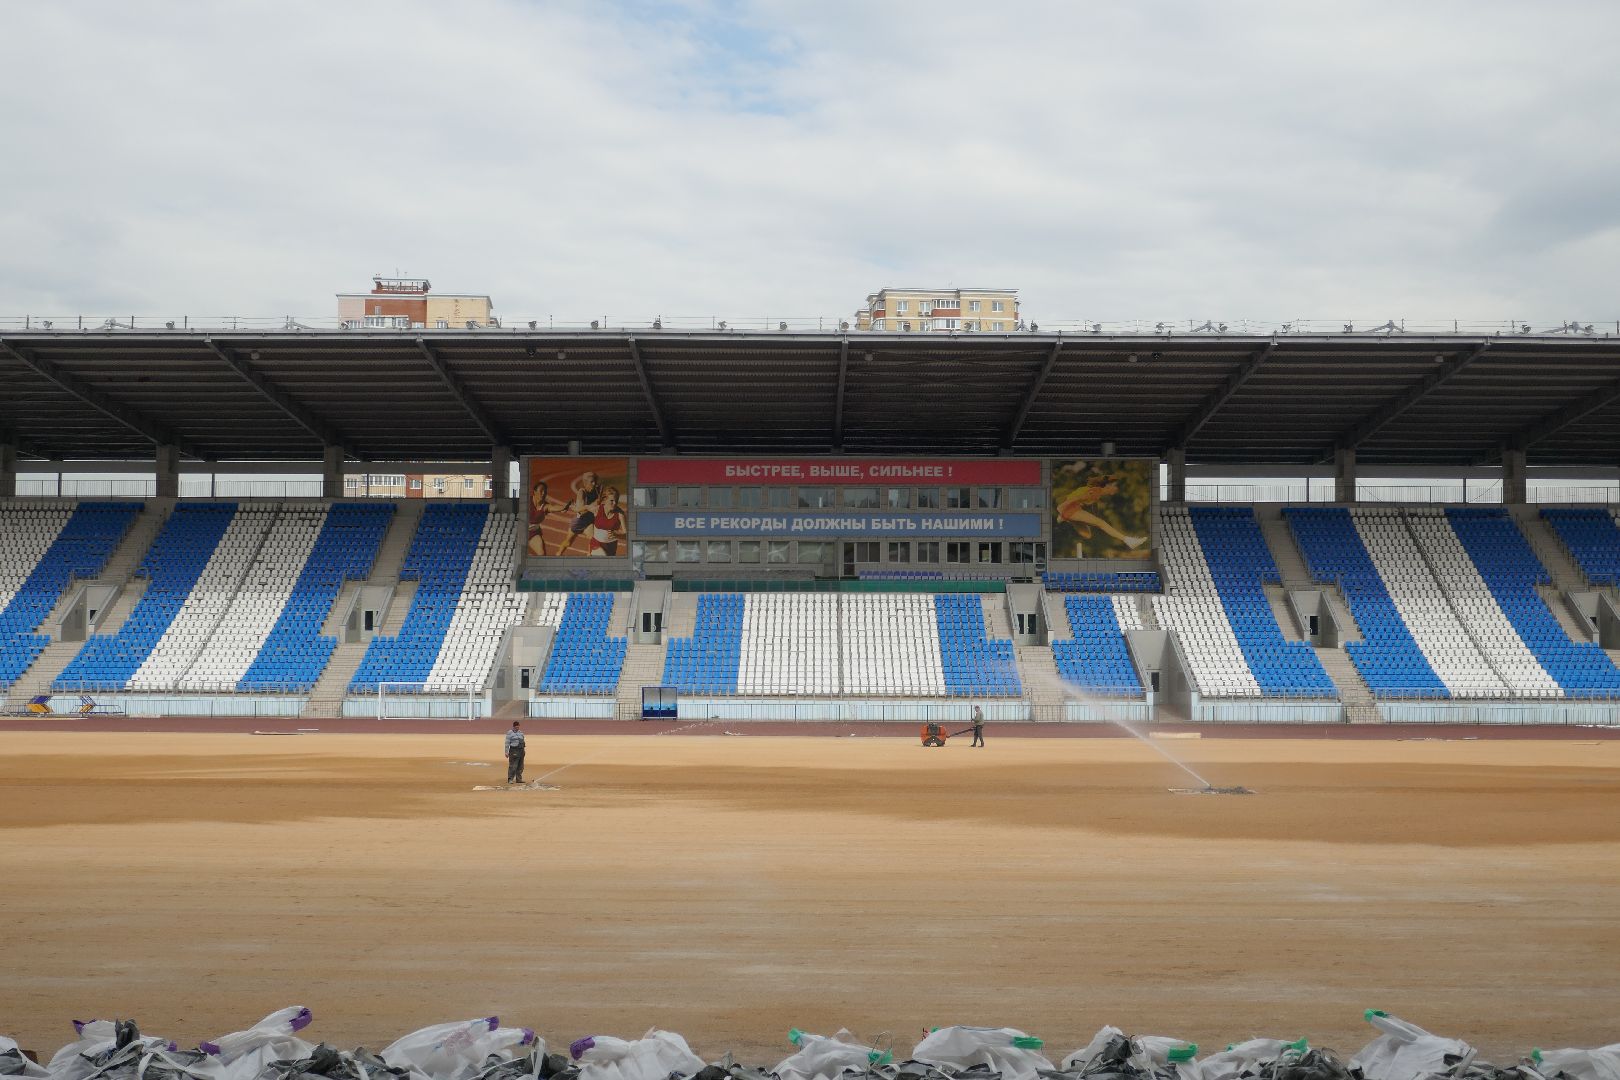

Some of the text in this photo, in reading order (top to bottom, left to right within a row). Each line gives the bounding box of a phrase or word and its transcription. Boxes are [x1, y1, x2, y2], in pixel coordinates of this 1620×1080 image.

[725, 465, 804, 479] БЫСТРЕЕ,
[809, 465, 864, 479] ВЫШЕ,
[674, 517, 706, 529] ВСЕ
[710, 517, 787, 531] РЕКОРДЫ
[791, 517, 866, 531] ДОЛЖНЫ
[871, 518, 917, 529] БЫТЬ
